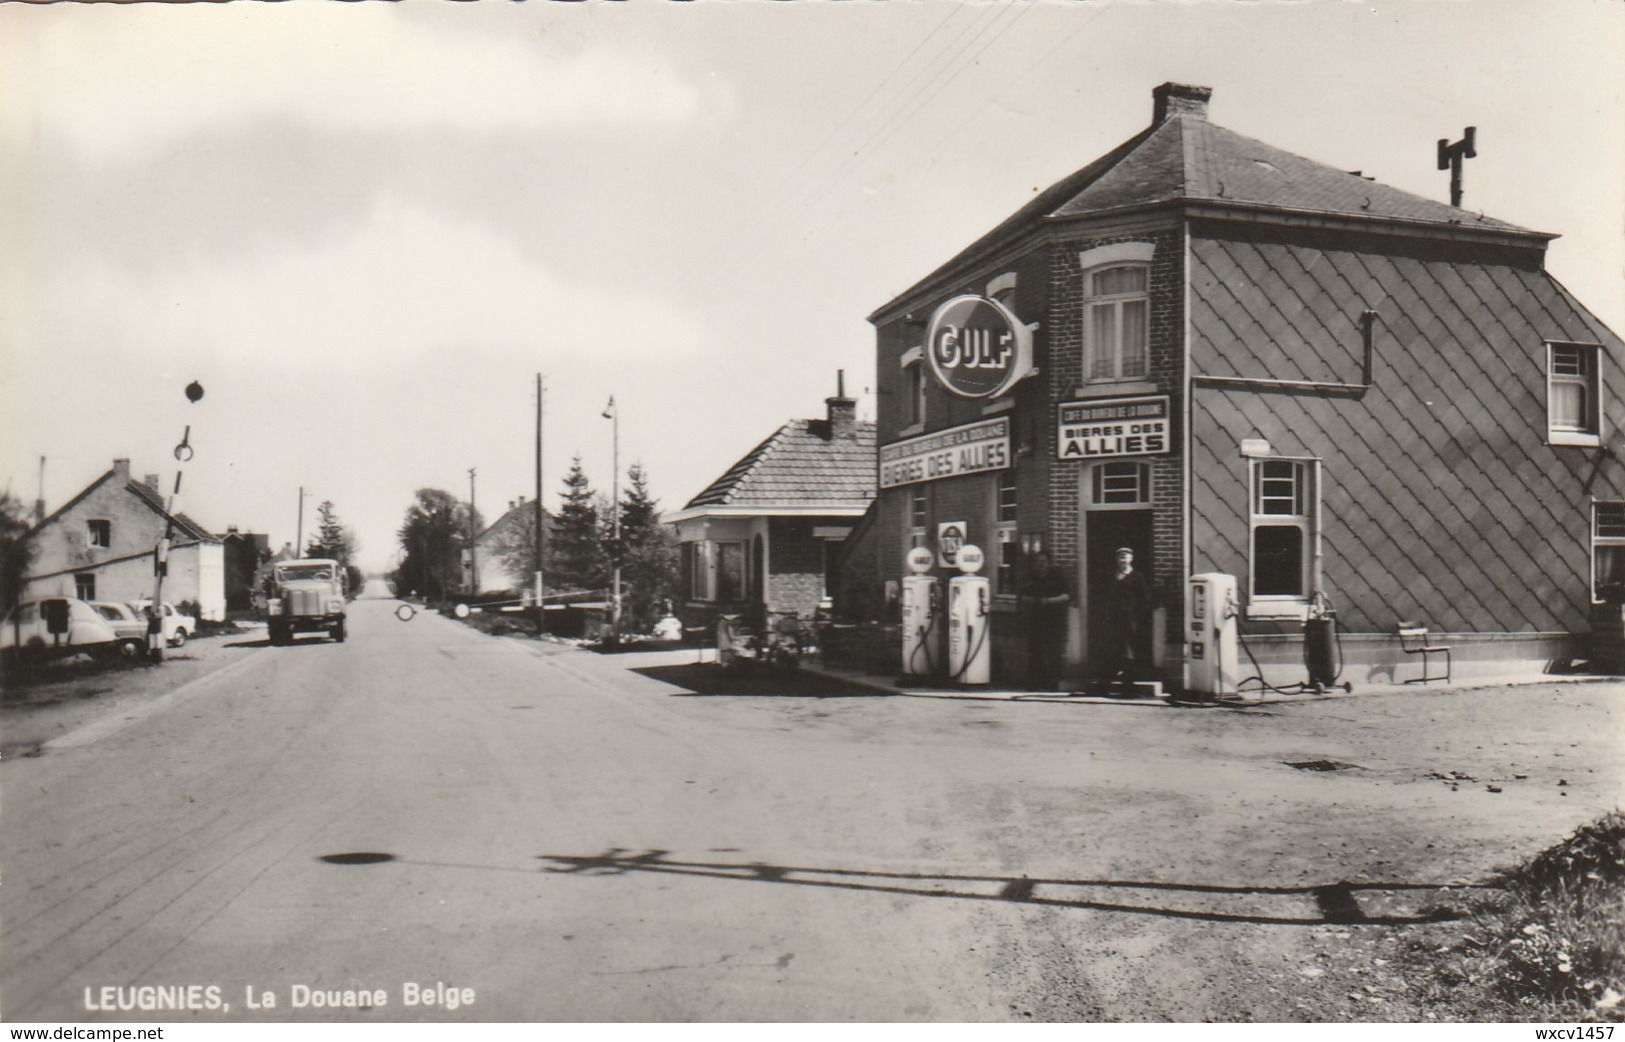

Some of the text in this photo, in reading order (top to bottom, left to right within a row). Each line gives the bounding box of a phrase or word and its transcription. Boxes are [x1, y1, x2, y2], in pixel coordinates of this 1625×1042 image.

[940, 325, 1012, 369] GULF
[956, 431, 968, 443] LA
[1065, 422, 1163, 439] BIERES DES
[1064, 434, 1163, 457] ALLIES
[883, 441, 1005, 485] BIERES DES ALLIES
